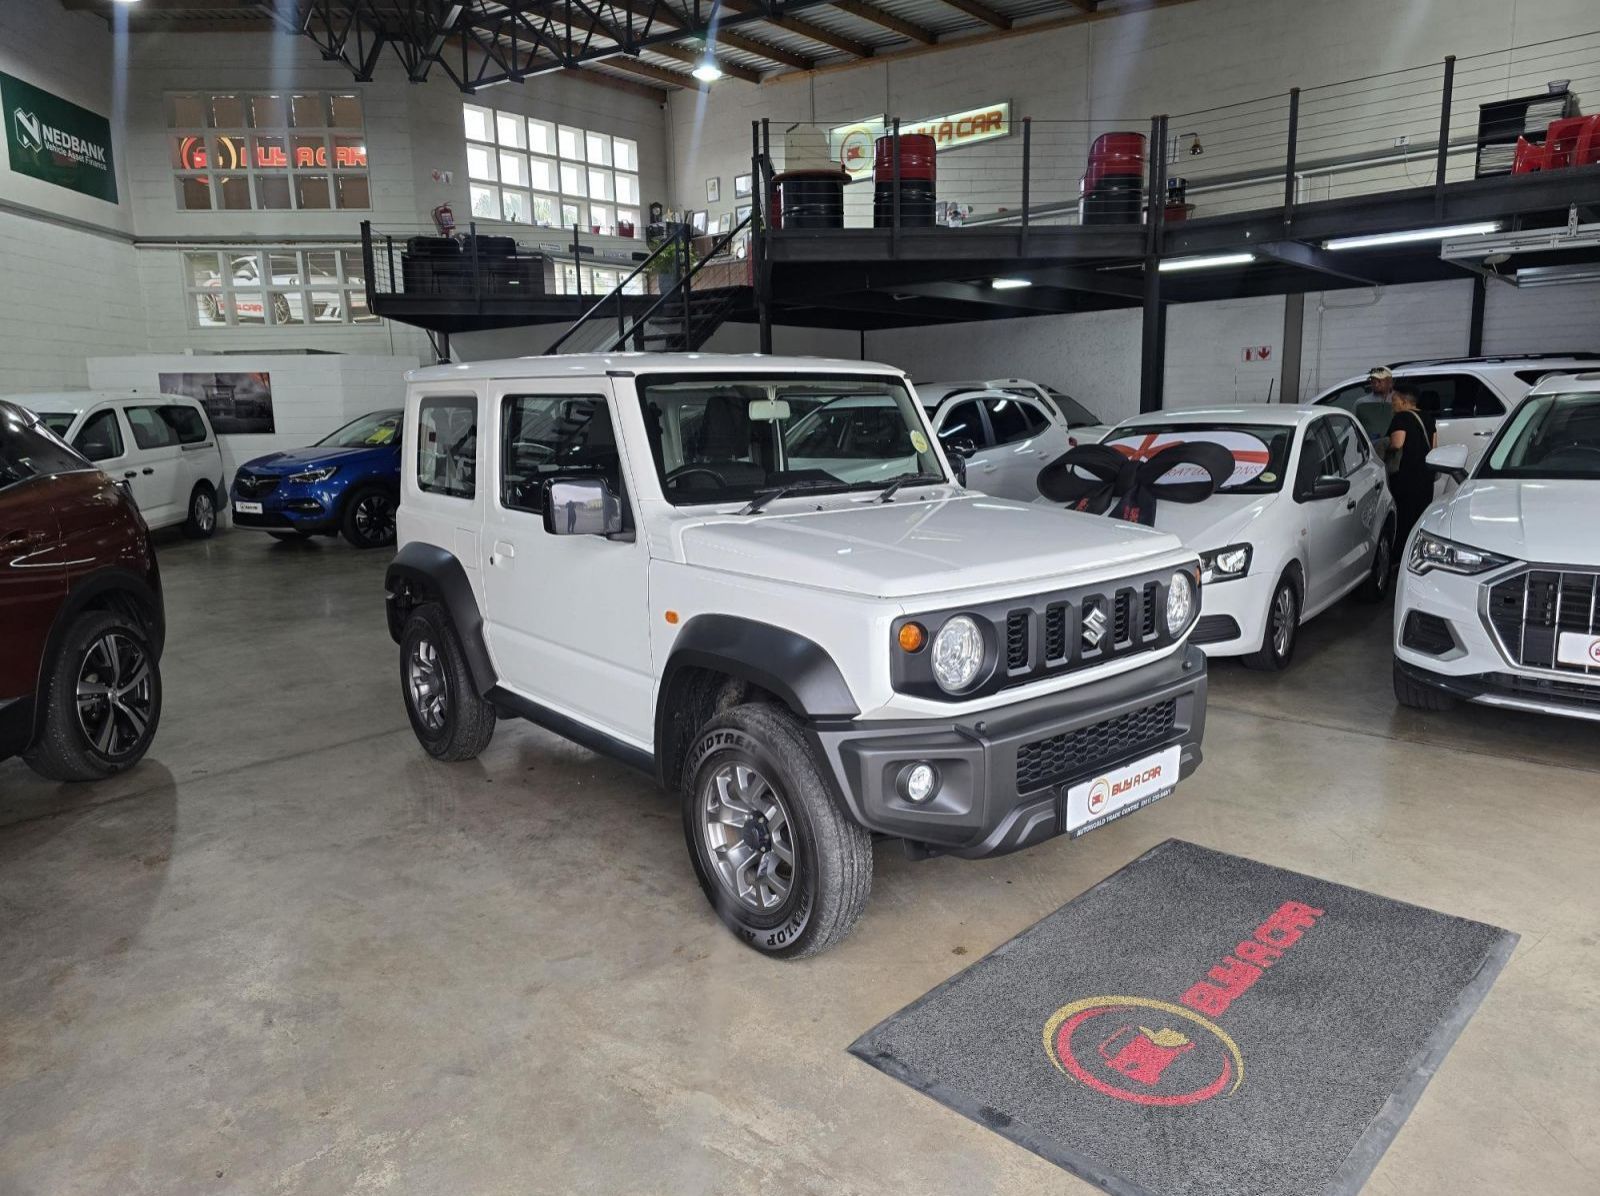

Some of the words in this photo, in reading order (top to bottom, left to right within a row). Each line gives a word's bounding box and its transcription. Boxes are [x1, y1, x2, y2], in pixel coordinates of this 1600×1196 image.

[957, 111, 1003, 139] CAR
[42, 124, 106, 162] NEDBANK
[45, 140, 67, 156] Vehicle
[293, 147, 314, 167] A
[316, 147, 367, 167] CAR
[1112, 777, 1133, 797] BUY
[1133, 774, 1141, 788] A
[1142, 766, 1162, 784] CAR
[1122, 803, 1140, 816] CENTRE
[1253, 900, 1326, 949] CAR
[1234, 940, 1284, 969] A
[1180, 957, 1263, 1018] BUY
